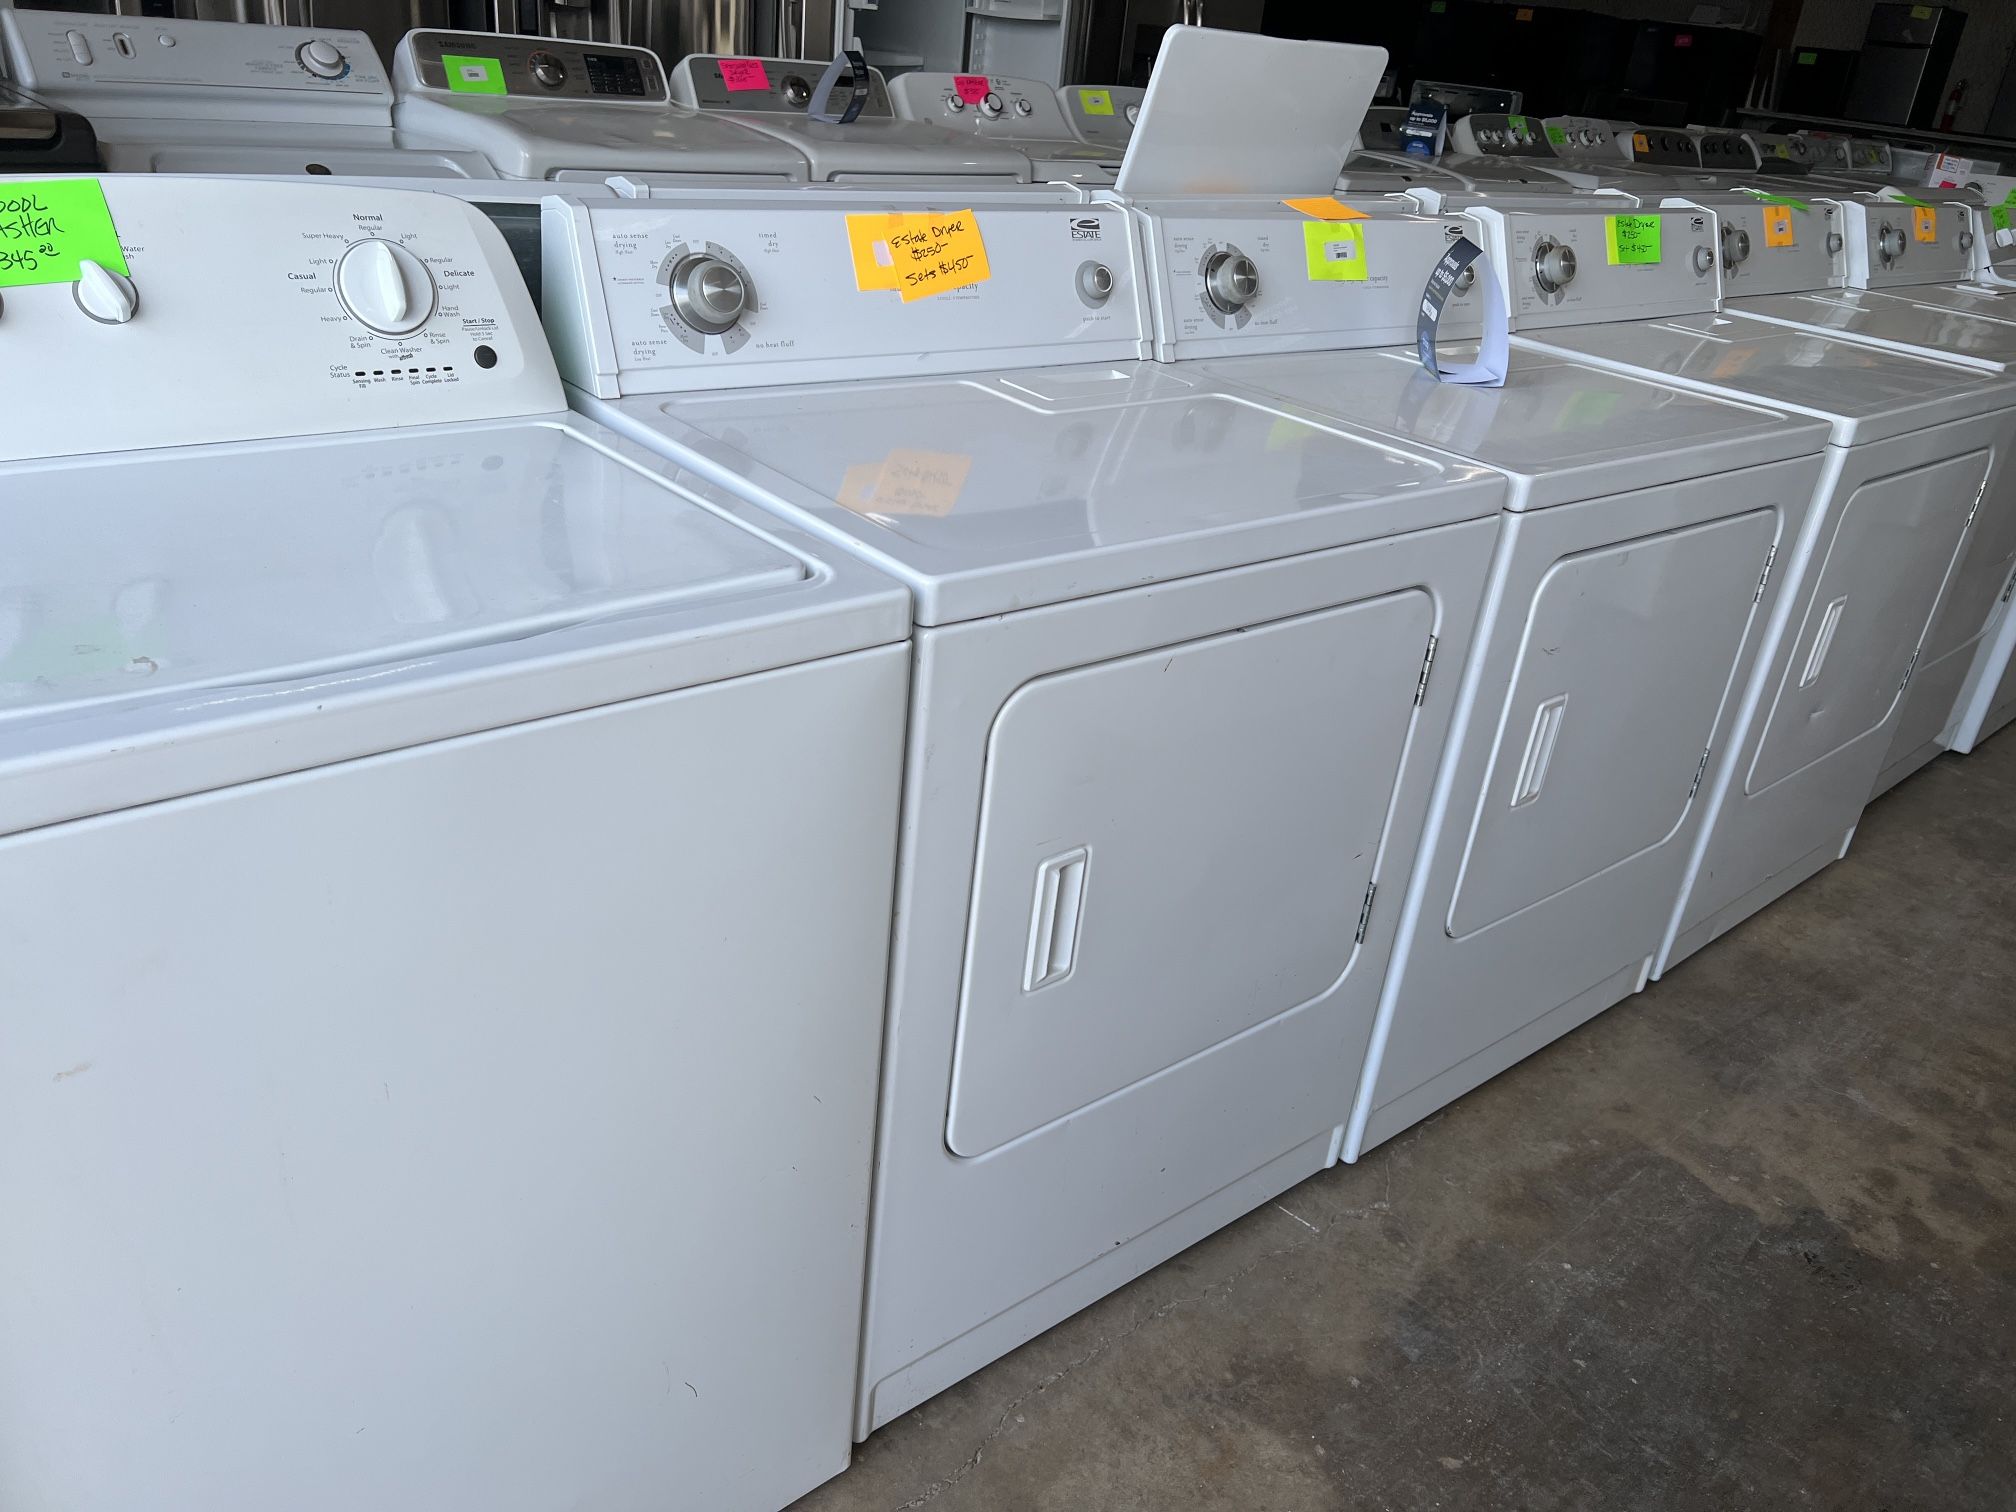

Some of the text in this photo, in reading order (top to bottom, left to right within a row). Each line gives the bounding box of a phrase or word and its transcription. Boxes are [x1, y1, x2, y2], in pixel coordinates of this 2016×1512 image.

[614, 241, 637, 249] drying
[768, 240, 778, 248] dry
[287, 272, 317, 280] Casual
[953, 283, 978, 293] pacity
[633, 348, 656, 356] drying
